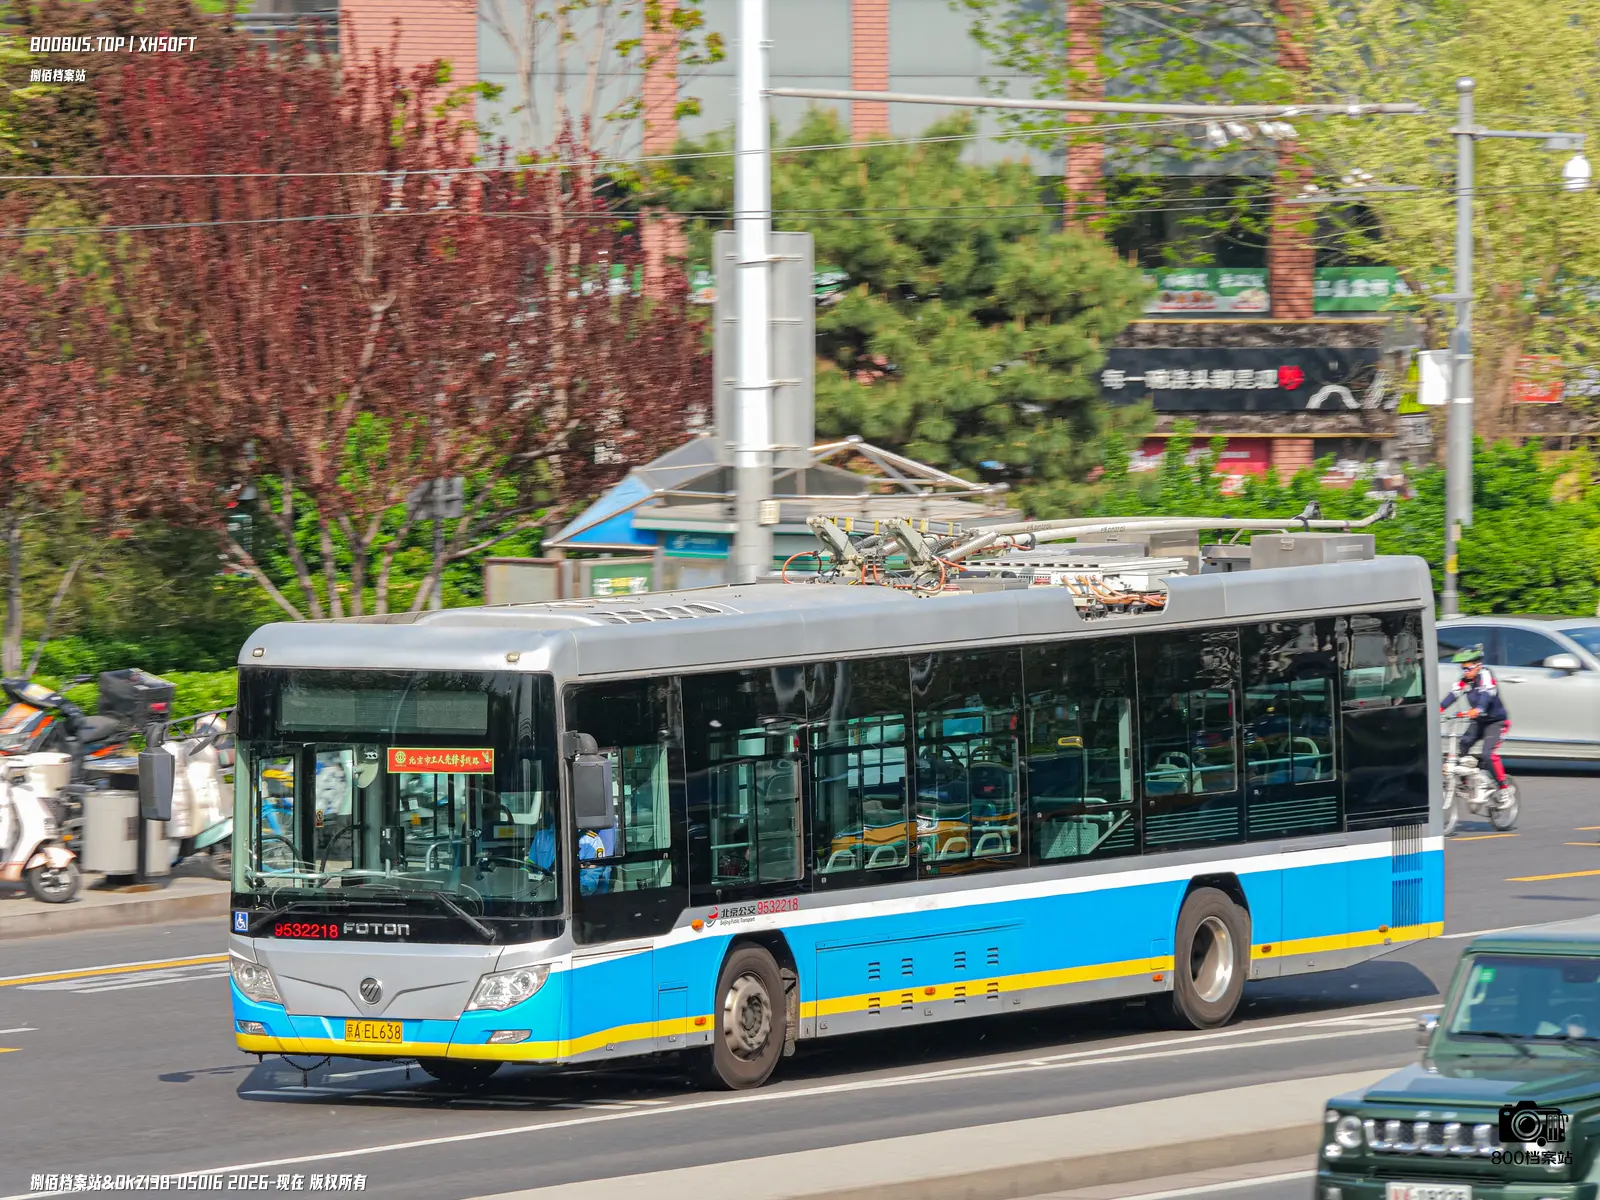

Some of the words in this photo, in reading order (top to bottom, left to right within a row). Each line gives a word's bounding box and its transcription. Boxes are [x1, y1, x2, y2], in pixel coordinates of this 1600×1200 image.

[721, 905, 756, 918] 北京公交
[757, 898, 798, 915] 9532218
[274, 924, 339, 939] 9532218
[343, 922, 410, 936] FOTON
